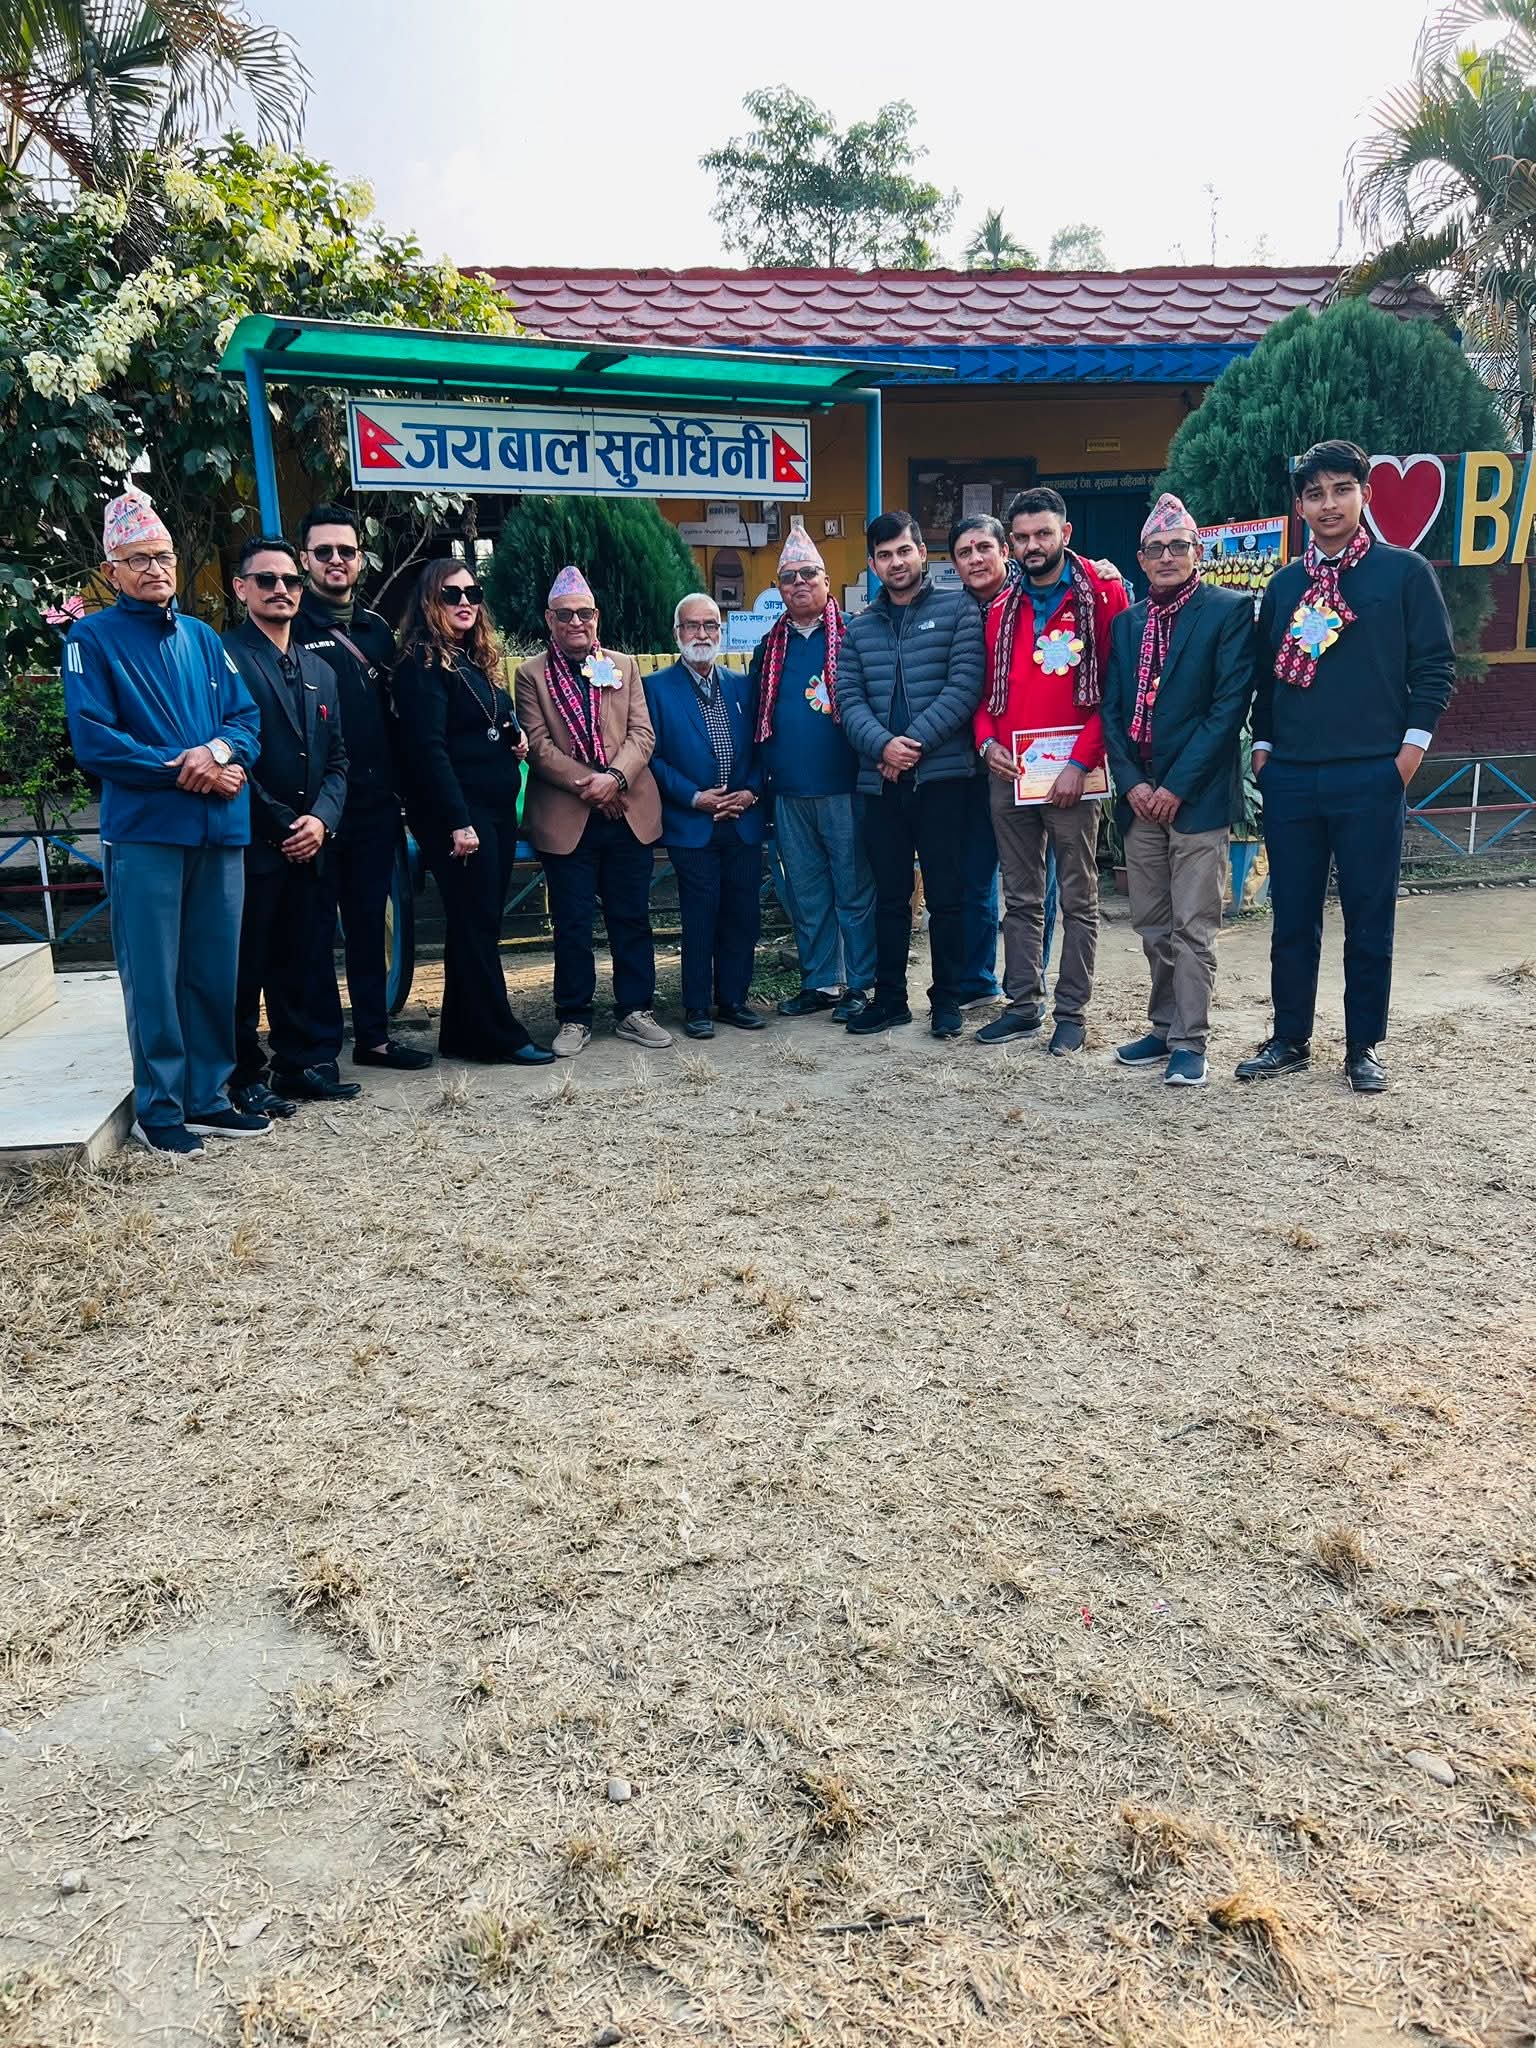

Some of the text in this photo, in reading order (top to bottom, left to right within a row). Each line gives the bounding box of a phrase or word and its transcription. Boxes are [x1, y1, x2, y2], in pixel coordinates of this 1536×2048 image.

[402, 422, 494, 471] जय
[497, 427, 591, 475] बाल
[1457, 450, 1536, 566] B
